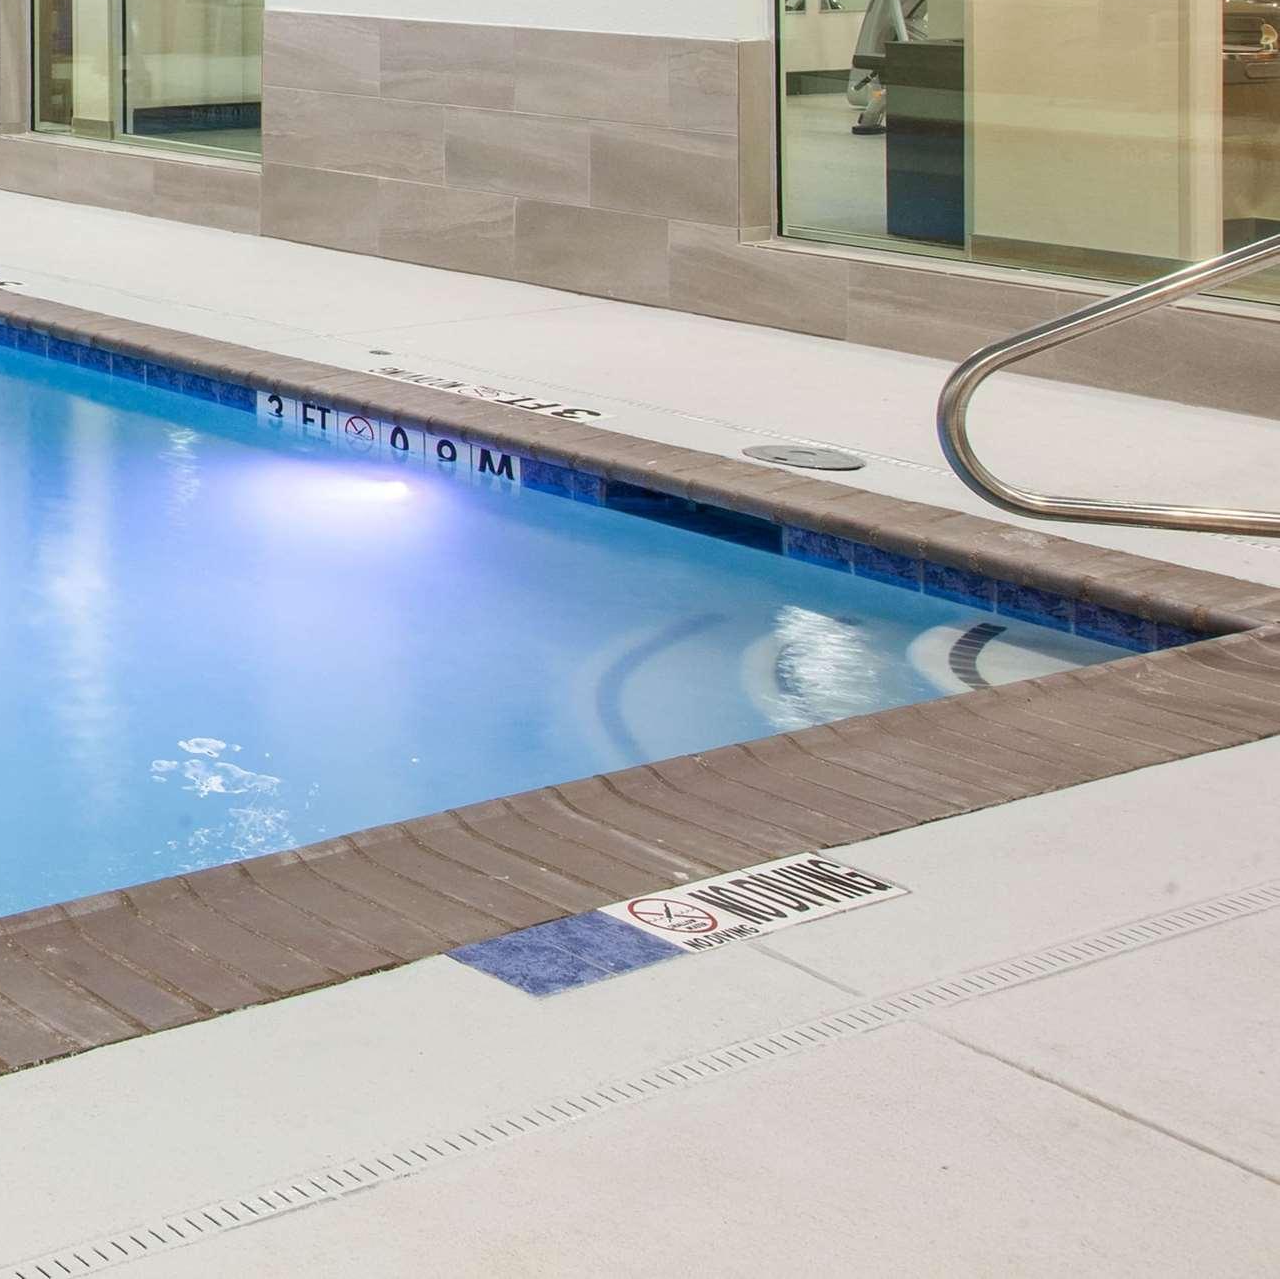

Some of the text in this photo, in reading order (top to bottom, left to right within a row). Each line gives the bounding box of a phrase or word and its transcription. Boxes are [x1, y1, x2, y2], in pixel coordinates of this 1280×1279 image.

[550, 407, 602, 419] 3
[267, 394, 284, 418] 3
[301, 403, 331, 430] FT
[478, 448, 515, 481] M
[687, 858, 893, 925] NO DIVING
[682, 924, 760, 951] NO DIVING
